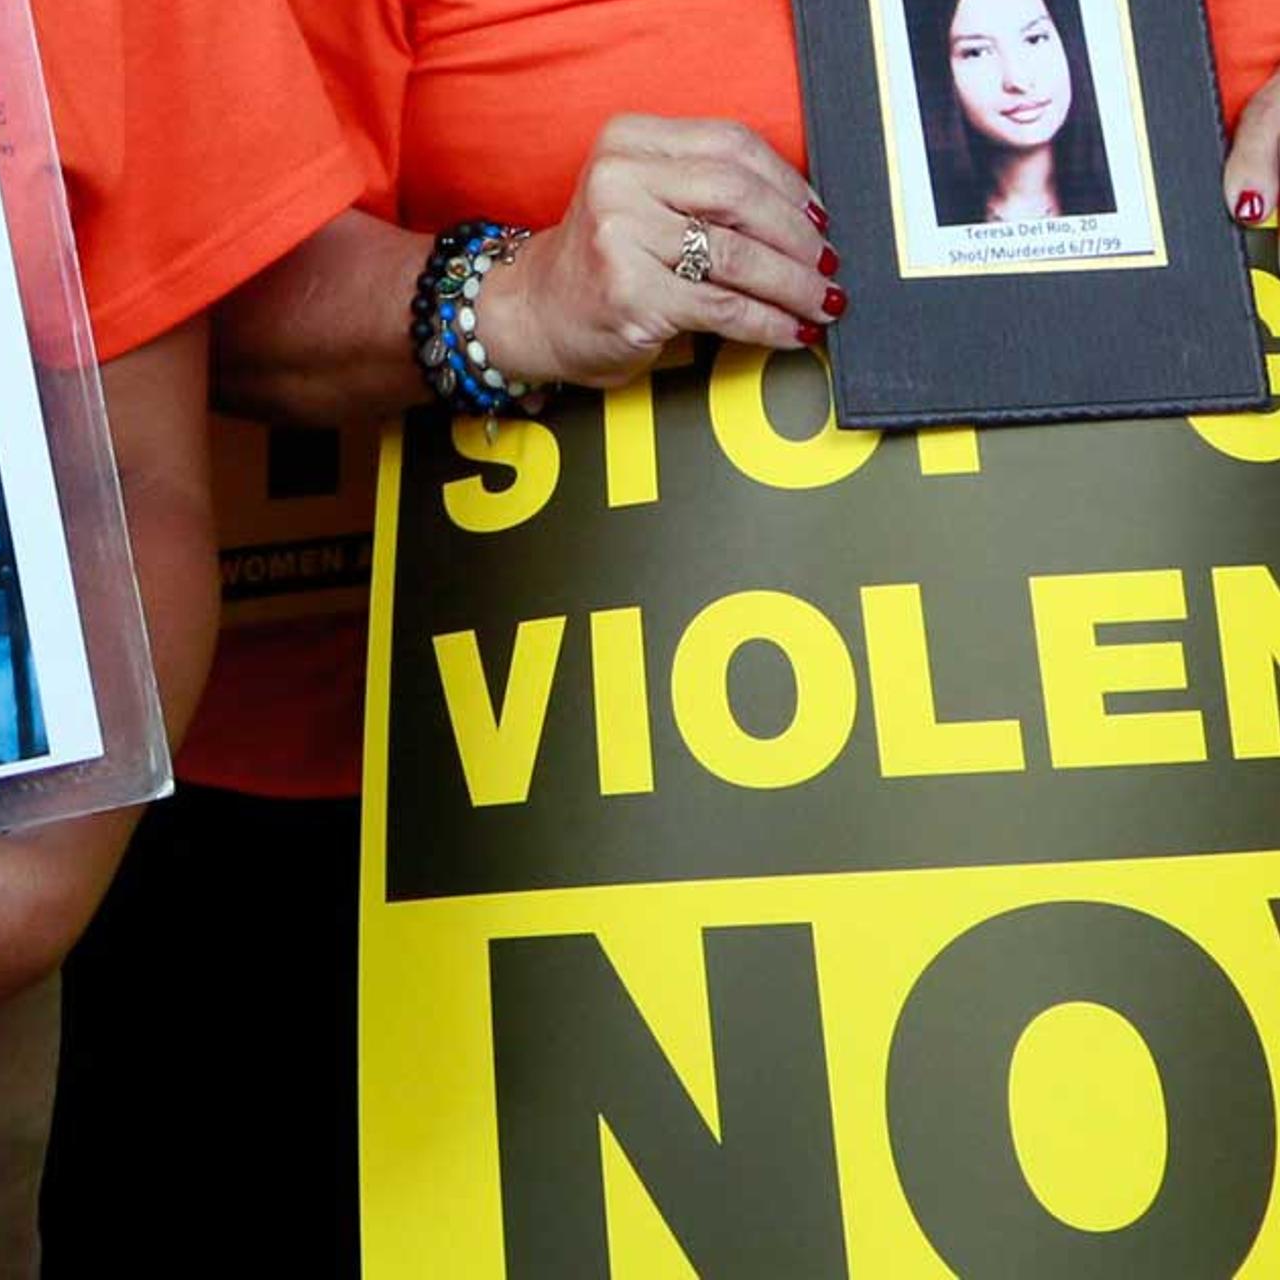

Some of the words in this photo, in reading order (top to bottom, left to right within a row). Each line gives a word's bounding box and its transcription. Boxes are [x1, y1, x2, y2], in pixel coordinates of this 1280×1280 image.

[965, 225, 1014, 240] Teresa
[1018, 221, 1043, 237] Del
[1080, 217, 1098, 231] 20
[948, 240, 1066, 264] Shot/Murdered
[487, 900, 1280, 1280] NO
